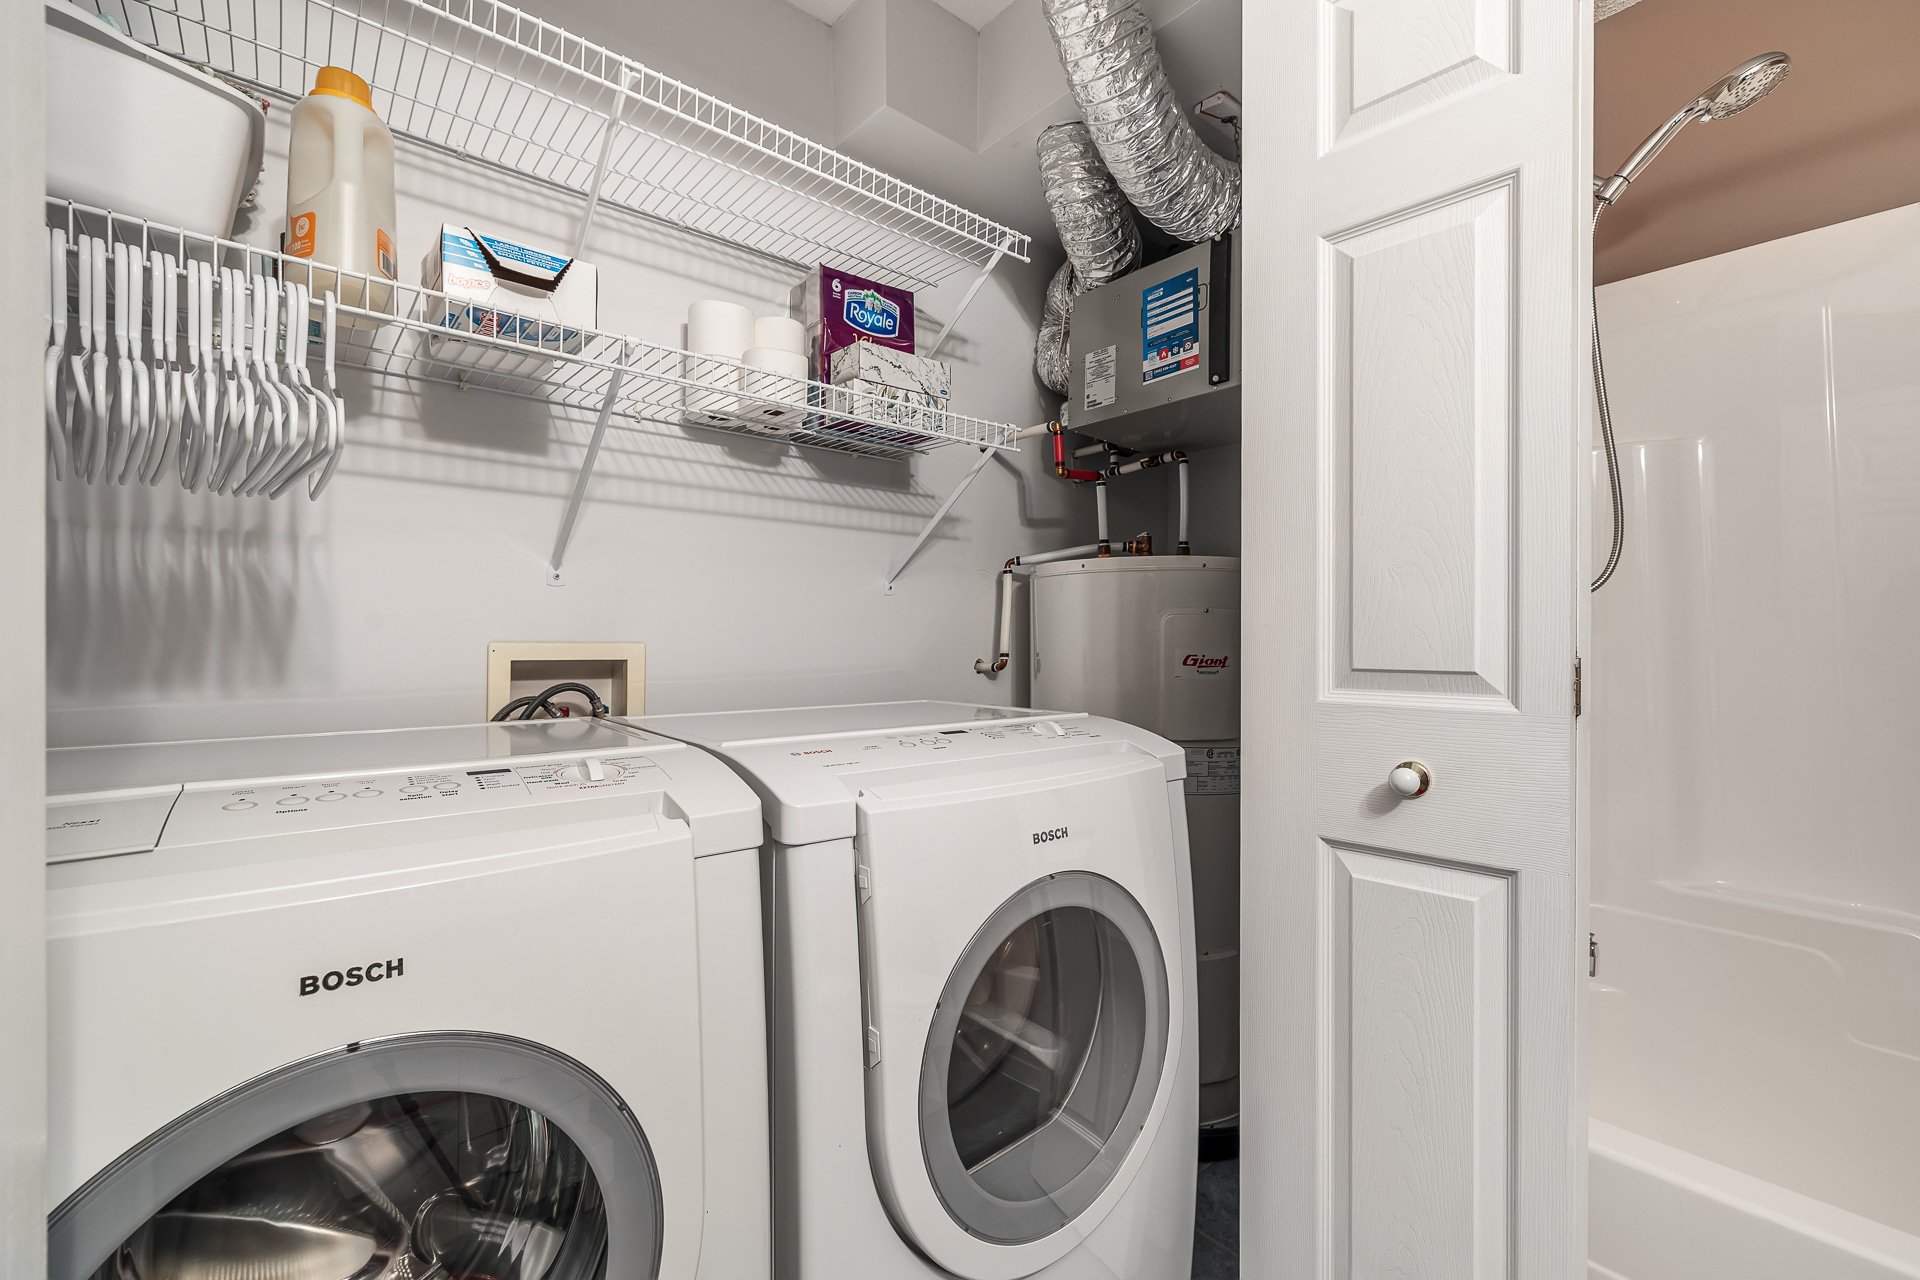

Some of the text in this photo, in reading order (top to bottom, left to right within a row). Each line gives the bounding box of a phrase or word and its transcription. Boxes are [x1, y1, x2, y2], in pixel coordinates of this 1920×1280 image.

[492, 244, 521, 256] MEDIUM
[494, 240, 519, 252] LARGE
[497, 250, 551, 270] SMALL PETITE
[831, 278, 842, 293] 6
[850, 302, 894, 330] Royale
[1182, 654, 1229, 668] Giant
[1032, 826, 1069, 845] BOSCH
[299, 957, 404, 997] BOSCH
